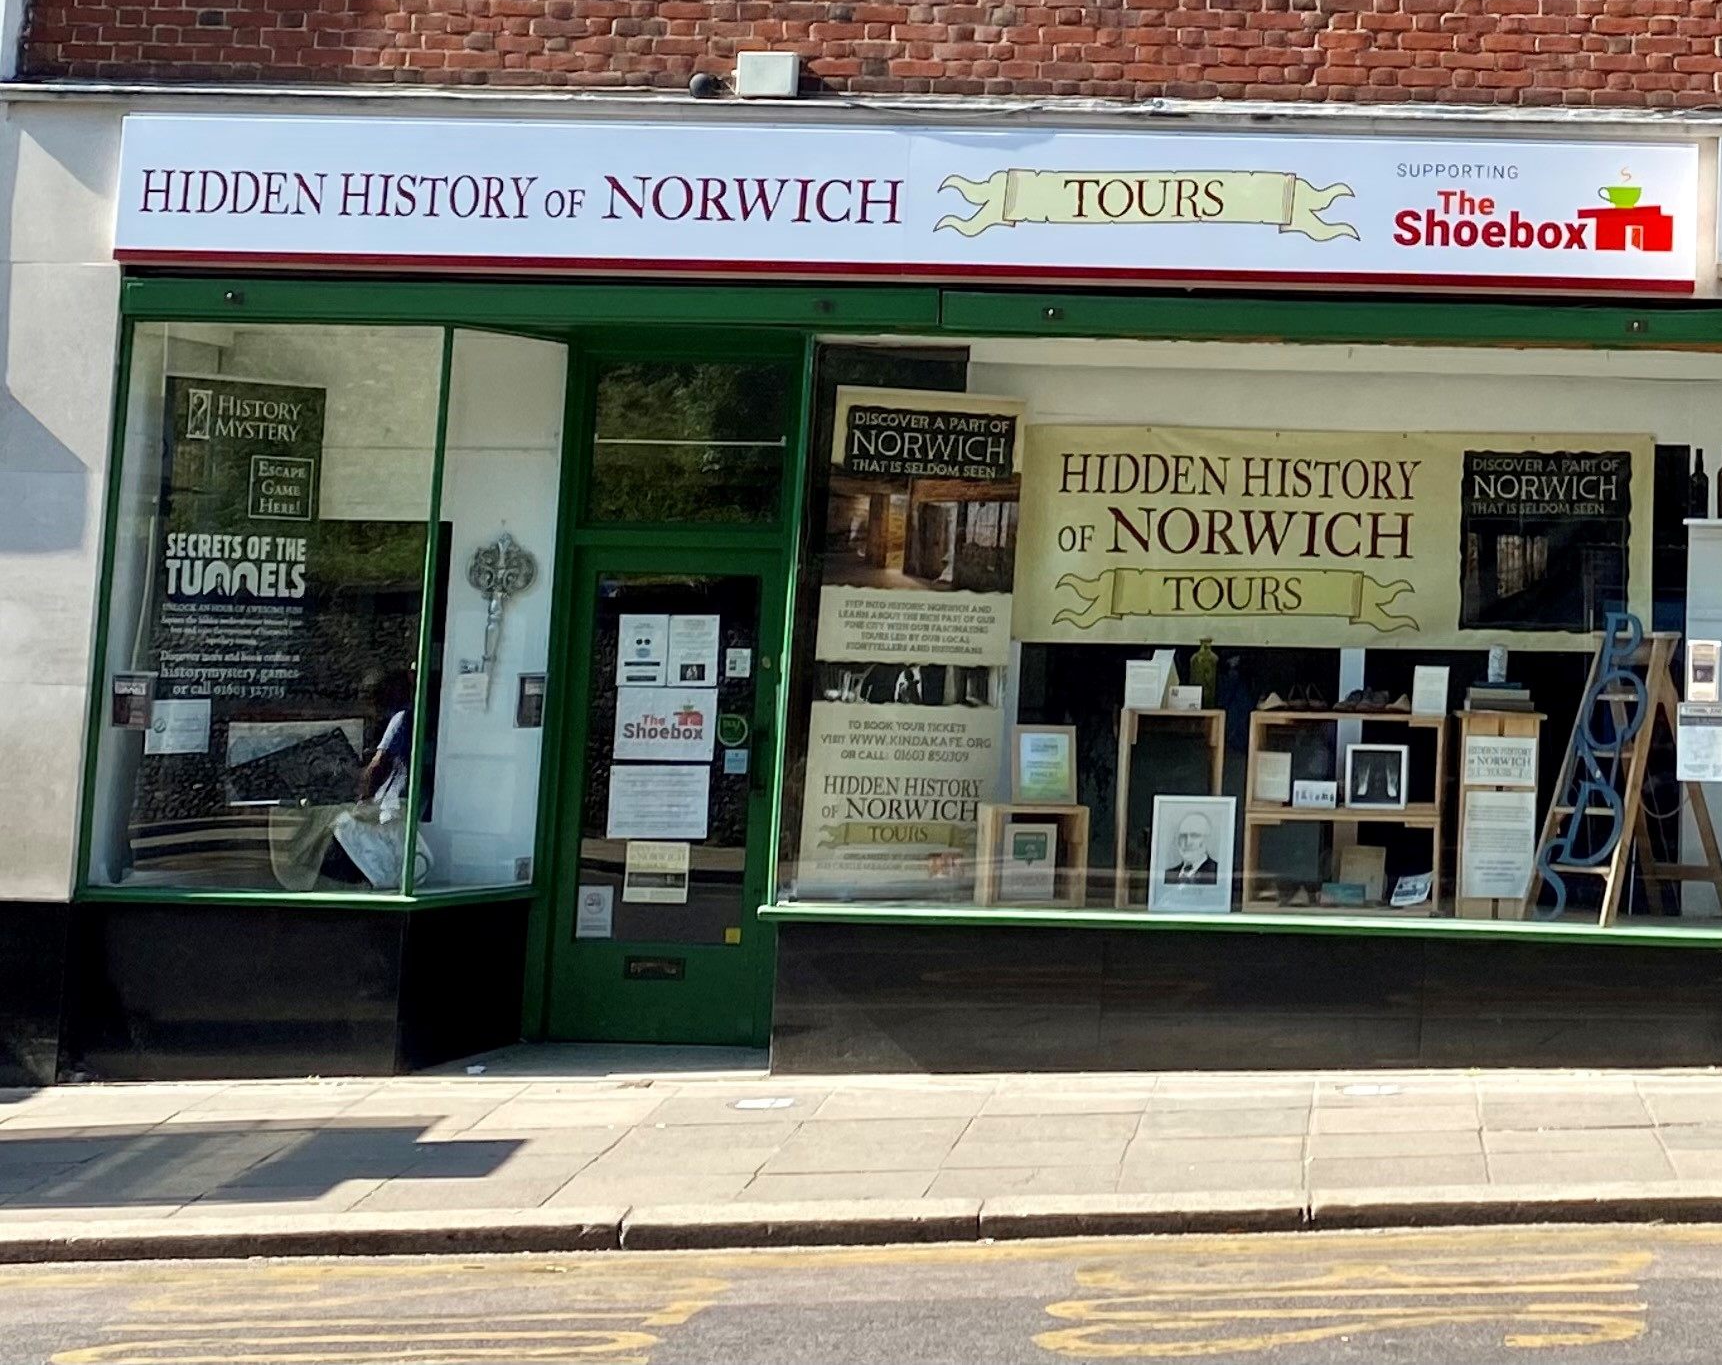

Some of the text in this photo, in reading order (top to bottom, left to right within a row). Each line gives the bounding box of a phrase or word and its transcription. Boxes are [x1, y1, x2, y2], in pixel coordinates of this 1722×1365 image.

[1397, 163, 1519, 180] SUPPORTING
[139, 169, 904, 225] HIDDEN HISTORY OF NORWICH
[1064, 178, 1226, 222] TOURS
[1437, 190, 1495, 216] The
[1394, 209, 1588, 251] Shoebox
[854, 411, 1011, 434] DISCOVER A PART OF
[852, 429, 1006, 464] NORWICH
[852, 458, 996, 479] THAT IS SELDOM SEEN
[1058, 452, 1422, 501] HIDDEN HISTORY
[1472, 458, 1621, 473] DISCOVER A PART OF
[1473, 474, 1618, 501] NORWICH
[1471, 501, 1605, 515] THAT IS SELDOM SEEN
[1058, 506, 1415, 559] OF NORWICH
[166, 533, 307, 562] SECRETS OF THE
[165, 558, 306, 599] TUNNELS
[1163, 576, 1302, 612] TOURS
[173, 685, 189, 695] or
[190, 680, 211, 695] call
[623, 723, 704, 740] Shoebox
[642, 714, 666, 726] The
[848, 720, 967, 733] TO BOOK YOUR TICKETS
[893, 749, 925, 762] 01603
[1476, 755, 1532, 767] NORWICH
[823, 775, 984, 799] HIDDEN HISTORY
[821, 797, 978, 822] OF NORWICH
[869, 825, 928, 843] TOURS
